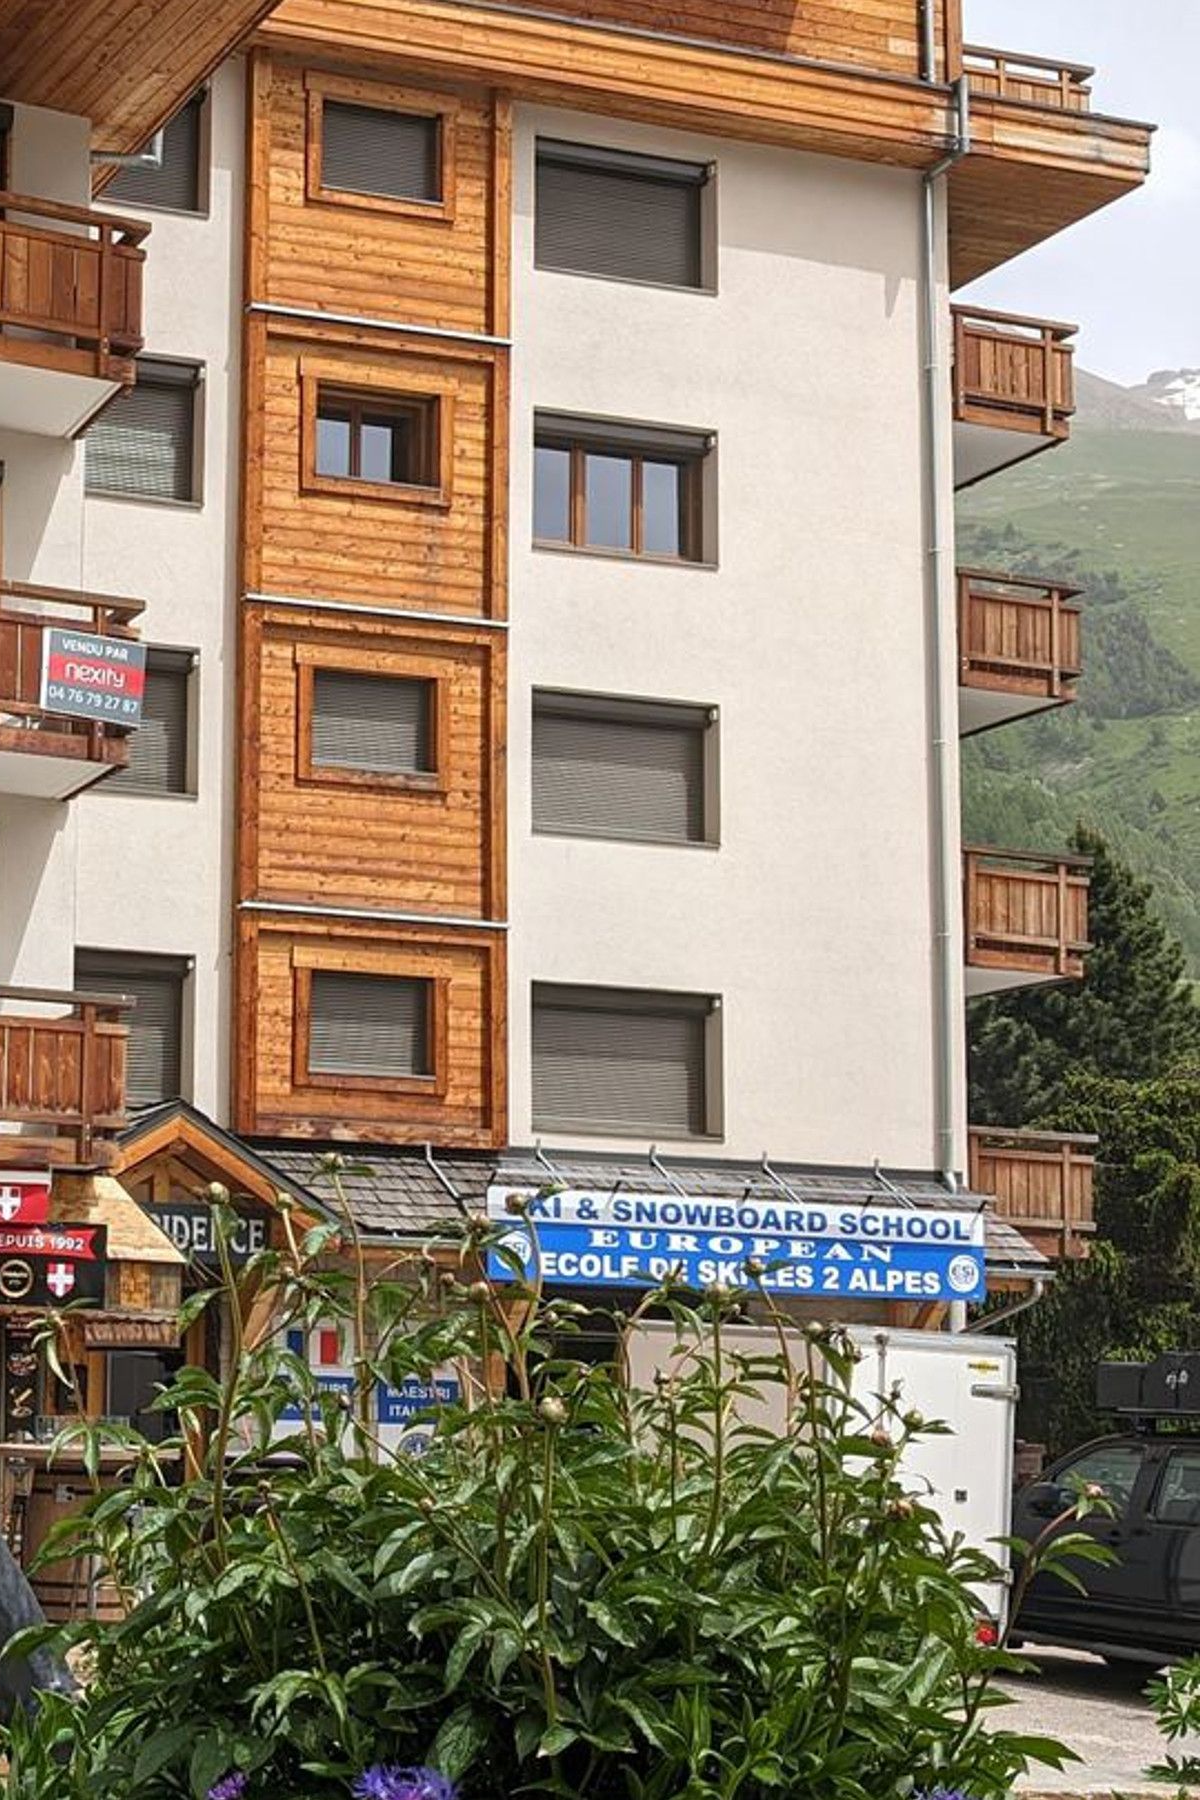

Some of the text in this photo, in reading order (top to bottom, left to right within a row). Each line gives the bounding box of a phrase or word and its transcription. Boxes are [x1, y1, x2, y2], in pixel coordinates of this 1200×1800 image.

[62, 638, 128, 660] VENDU PAR
[64, 662, 126, 688] nexity
[48, 685, 138, 713] 04 76 79 27 87
[576, 1198, 599, 1220] &
[613, 1200, 828, 1233] SNOWBOARD
[839, 1213, 970, 1241] SCHOOL
[48, 1236, 84, 1251] 1992
[589, 1229, 894, 1263] EUROPEAN
[823, 1266, 840, 1290] 2
[849, 1268, 941, 1295] ALPES
